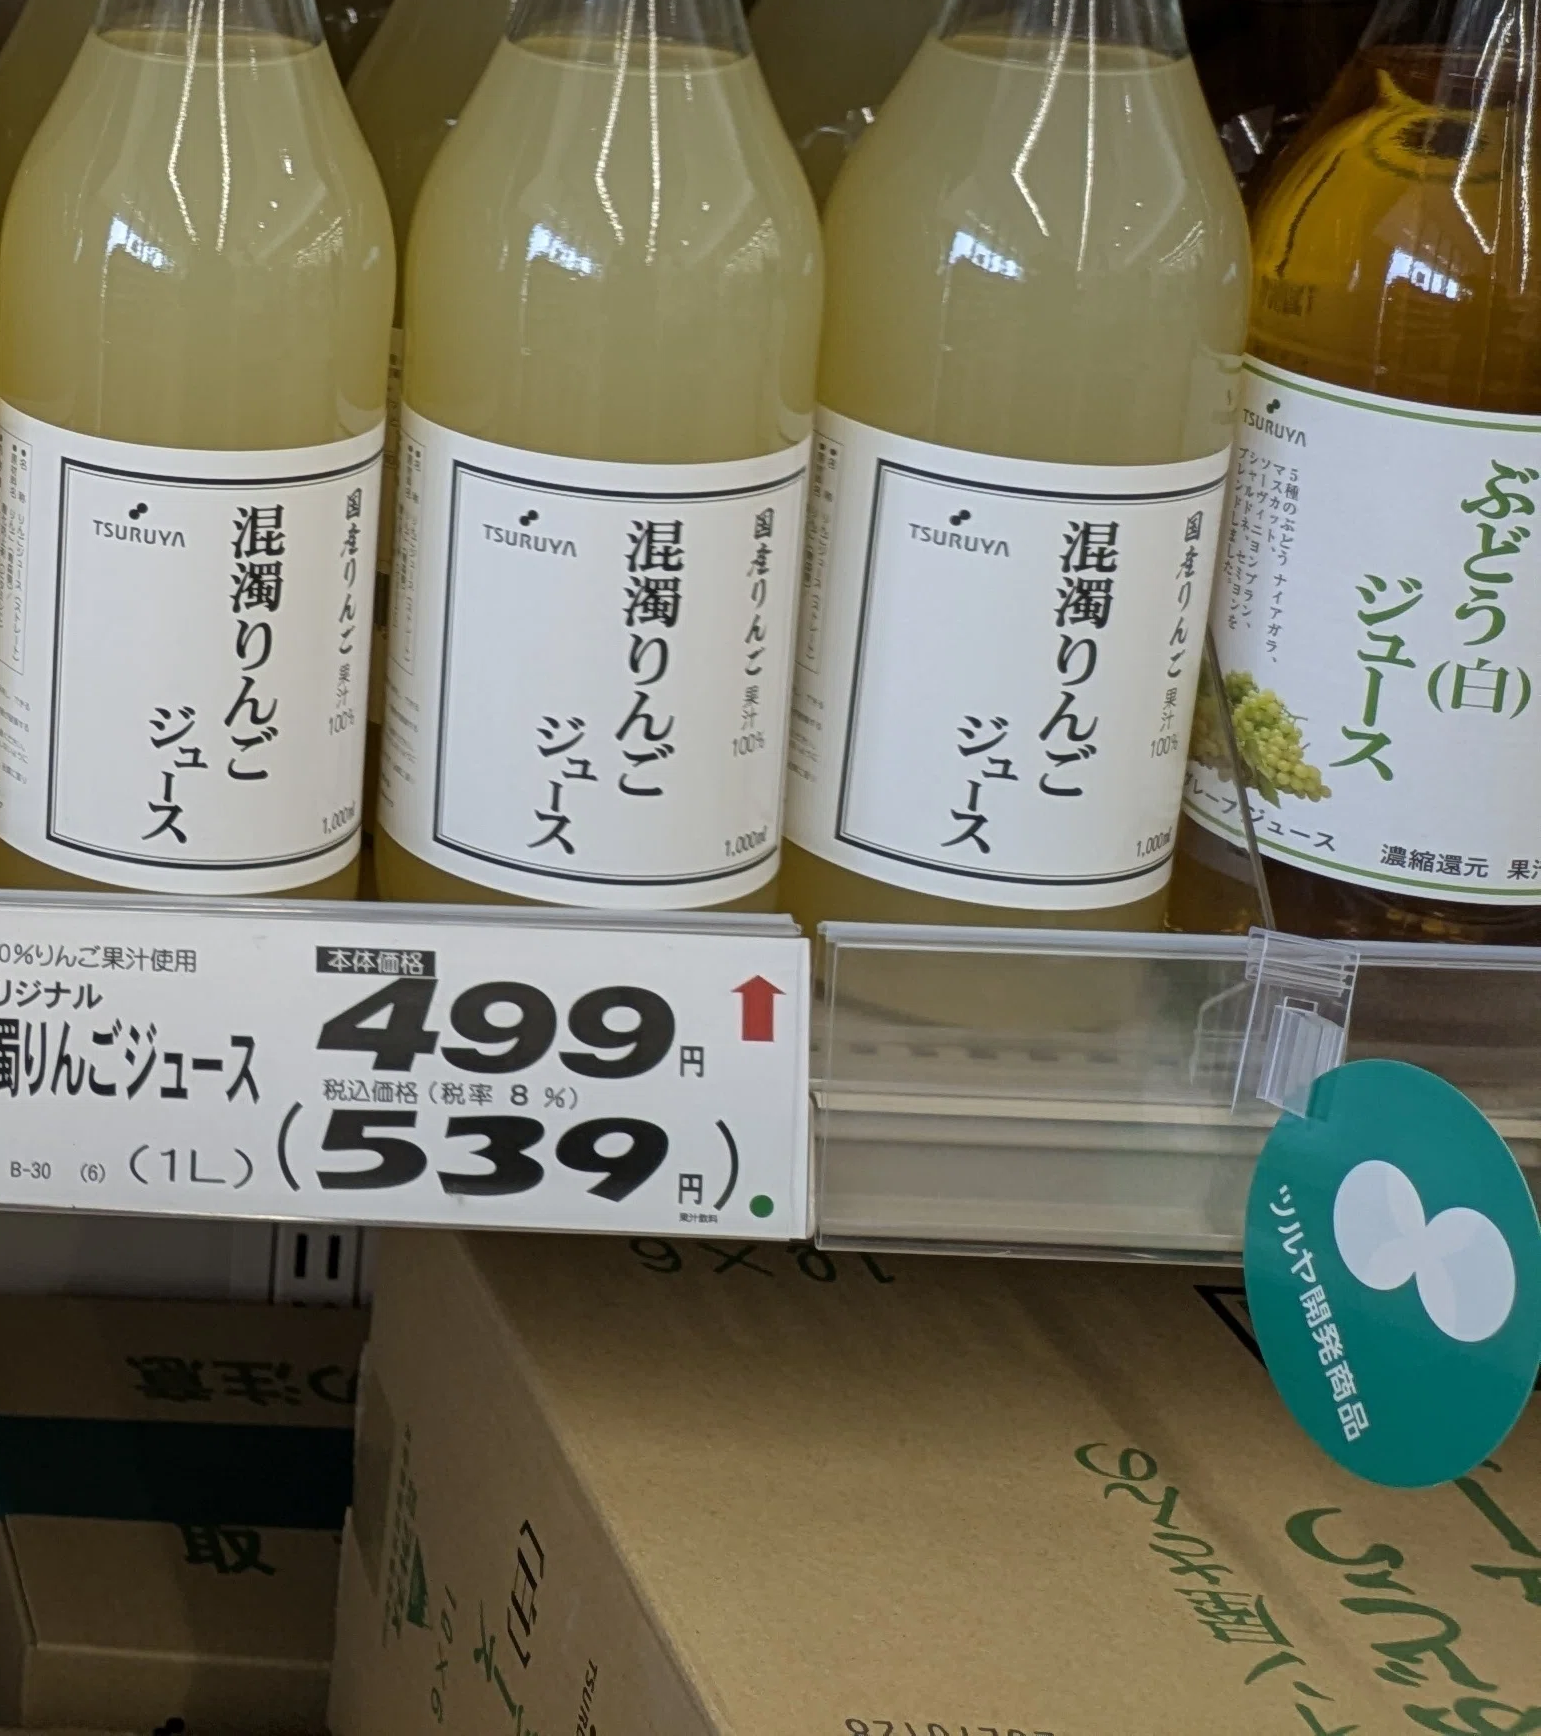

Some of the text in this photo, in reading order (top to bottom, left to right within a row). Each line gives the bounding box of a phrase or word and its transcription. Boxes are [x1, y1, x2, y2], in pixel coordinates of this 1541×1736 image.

[1243, 408, 1307, 448] TSURUYA
[93, 518, 186, 548] TSURUYA
[482, 524, 577, 558] TSURUYA
[909, 523, 1009, 559] TSURUYA
[1455, 459, 1539, 646] ぶどう
[223, 504, 286, 780] 混濁りんご
[615, 519, 684, 799] 混濁りんご
[1038, 521, 1119, 799] 混濁りんご
[1329, 574, 1423, 781] ジュース
[141, 706, 209, 843] ジュース
[527, 715, 598, 855] ジュース
[940, 715, 1018, 854] ジュース
[1380, 843, 1489, 879] 濃縮還元
[327, 950, 425, 974] 本体価格
[11, 1161, 51, 1179] B-30
[679, 1212, 718, 1224] 果汁飲料
[1269, 1185, 1370, 1442] ツルヤ開発商品
